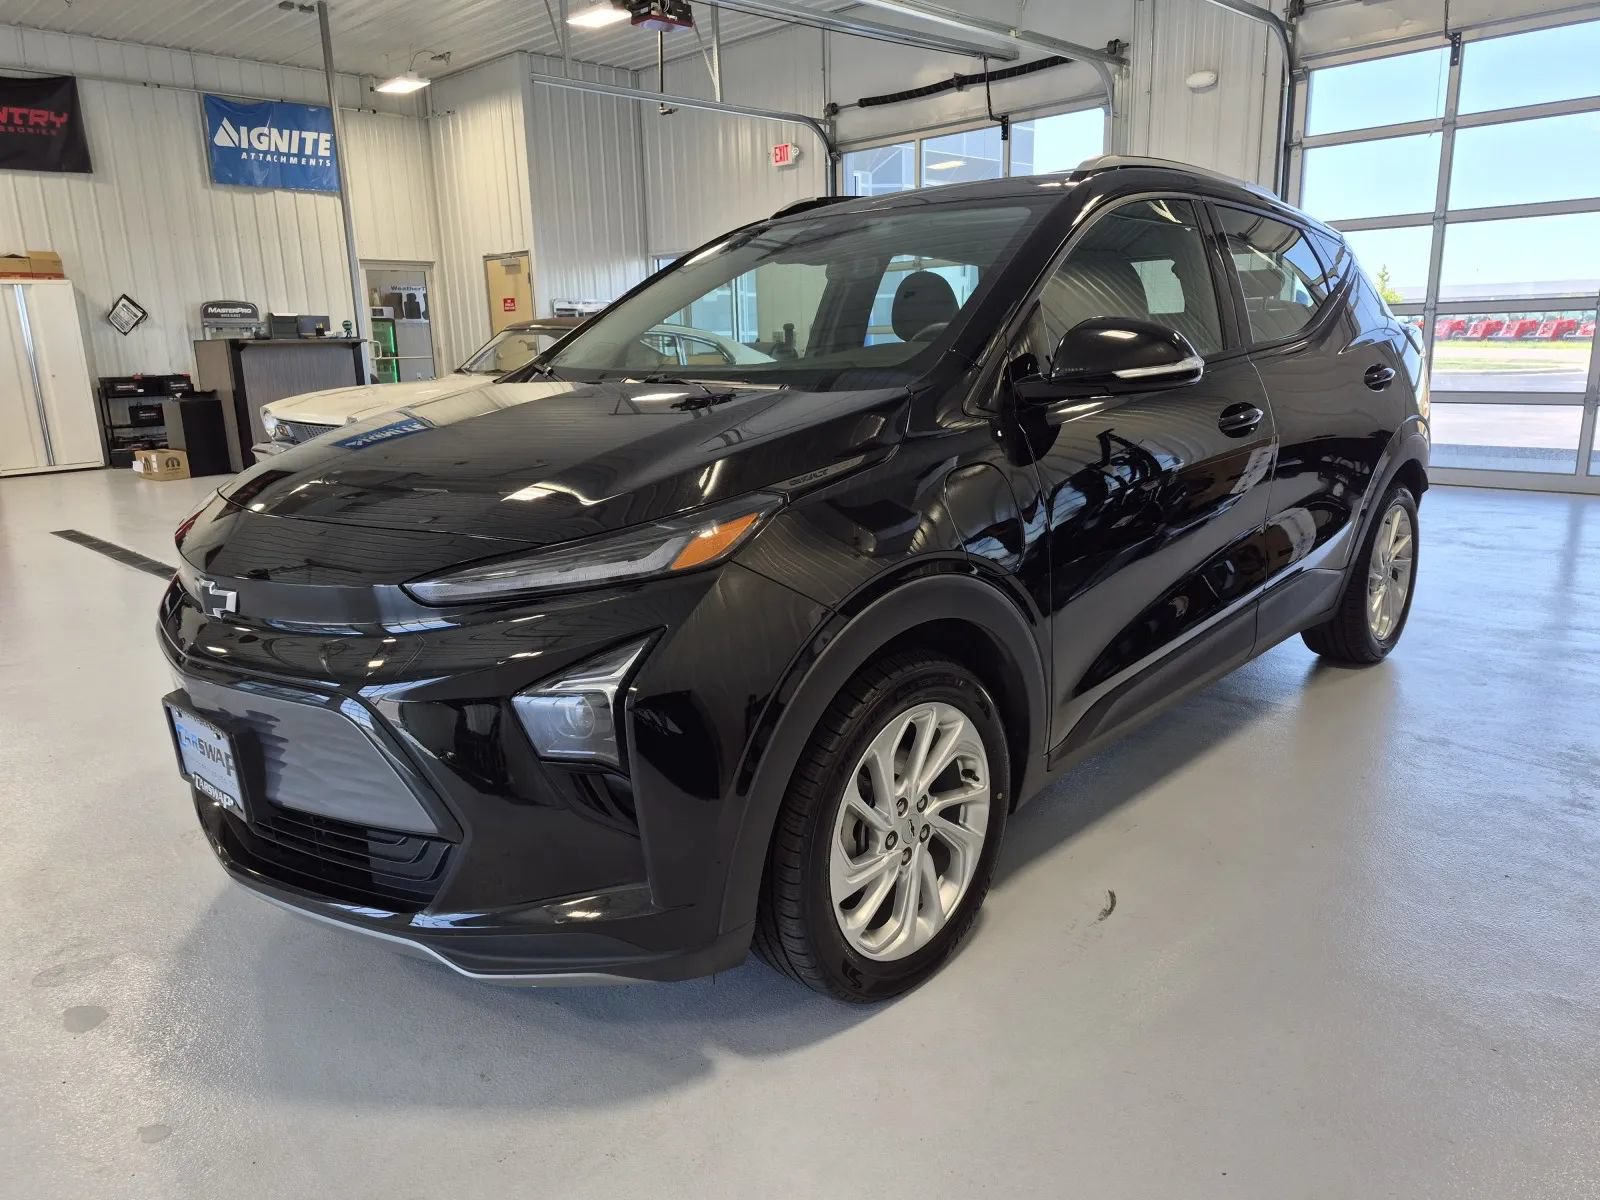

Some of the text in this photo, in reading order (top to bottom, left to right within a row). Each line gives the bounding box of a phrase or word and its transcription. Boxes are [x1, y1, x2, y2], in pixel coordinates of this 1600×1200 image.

[240, 126, 331, 157] IGNITE
[241, 151, 331, 167] ATTACHMENTS
[775, 144, 789, 163] EXIT
